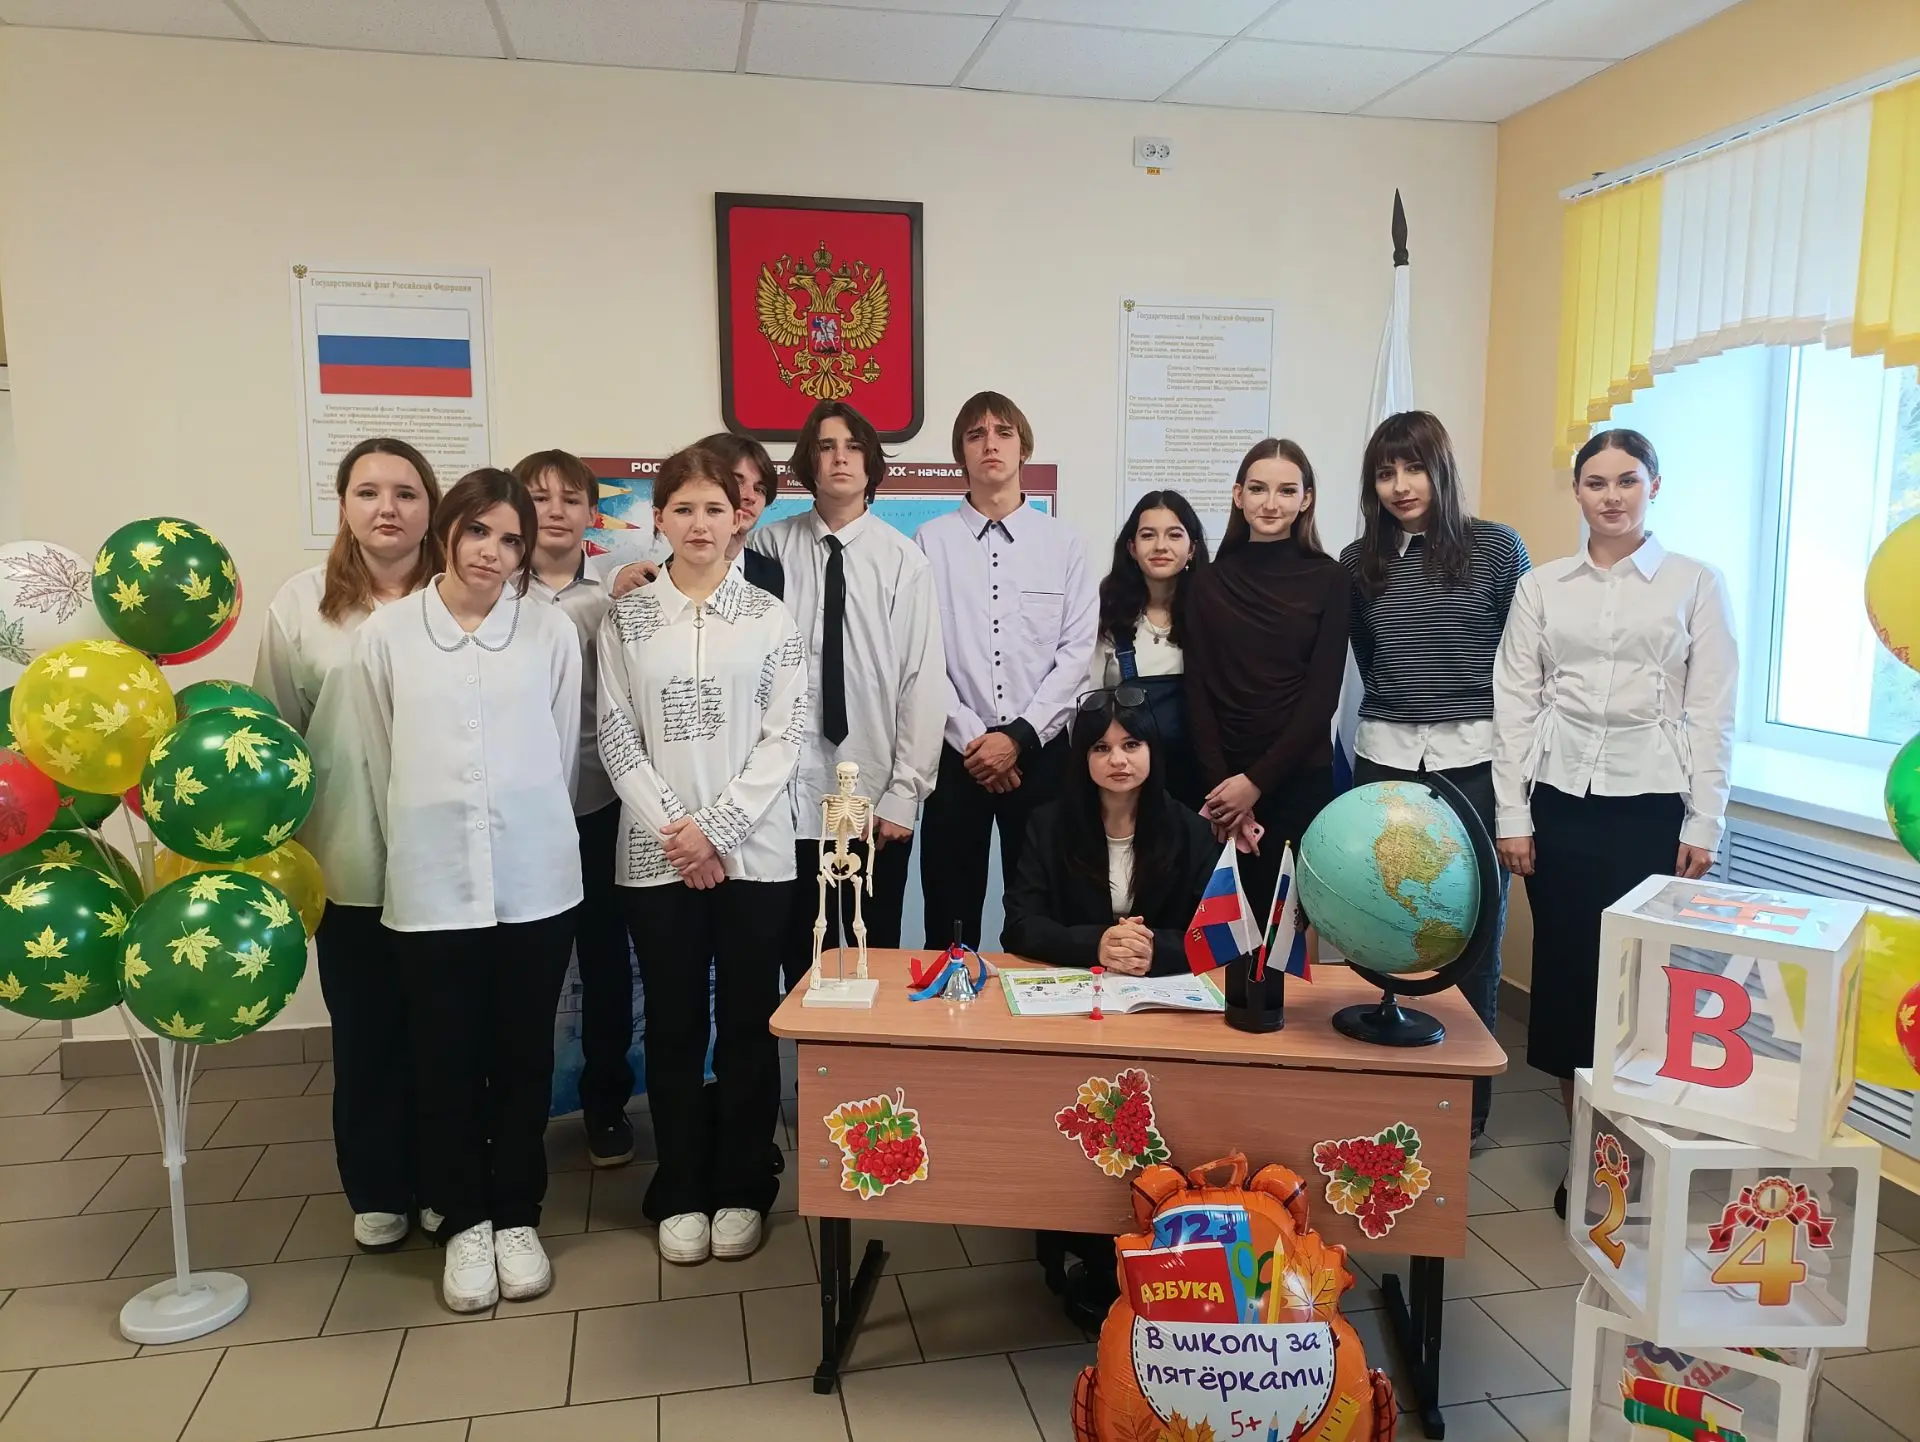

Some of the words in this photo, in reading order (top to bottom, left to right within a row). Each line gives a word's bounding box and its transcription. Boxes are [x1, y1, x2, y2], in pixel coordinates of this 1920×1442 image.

[917, 467, 963, 478] начале
[1655, 965, 1754, 1089] В
[1164, 1214, 1239, 1244] 123
[1711, 1213, 1808, 1307] 4
[1140, 1279, 1225, 1304] АЗБУКА
[1172, 1332, 1279, 1365] школу
[1289, 1330, 1321, 1354] за
[1146, 1361, 1325, 1402] пятёрками
[1230, 1409, 1263, 1438] 5+
